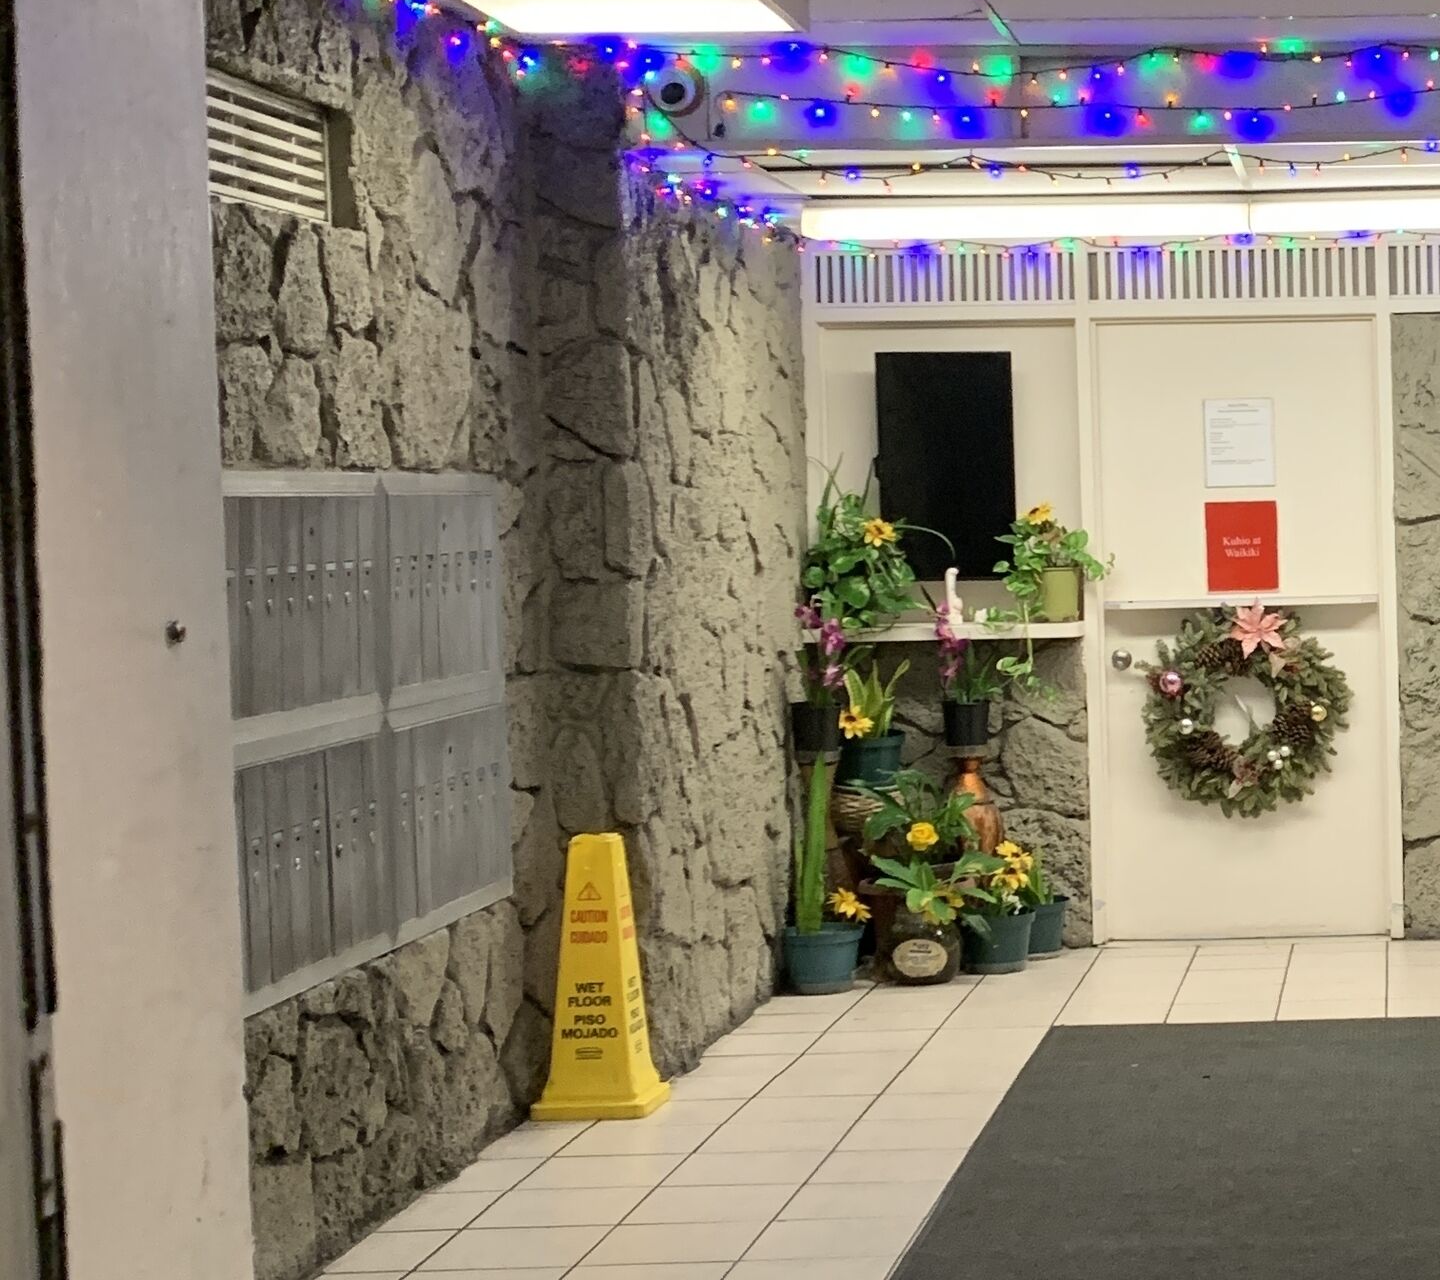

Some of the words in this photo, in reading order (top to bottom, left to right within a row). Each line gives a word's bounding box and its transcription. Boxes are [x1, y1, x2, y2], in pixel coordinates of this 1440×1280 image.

[1223, 536, 1251, 546] Kuhio
[1225, 548, 1260, 558] Waikiki
[576, 982, 604, 993] WET
[568, 995, 611, 1007] FLOOR
[574, 1014, 606, 1025] PISO
[562, 1027, 618, 1039] MOJADO
